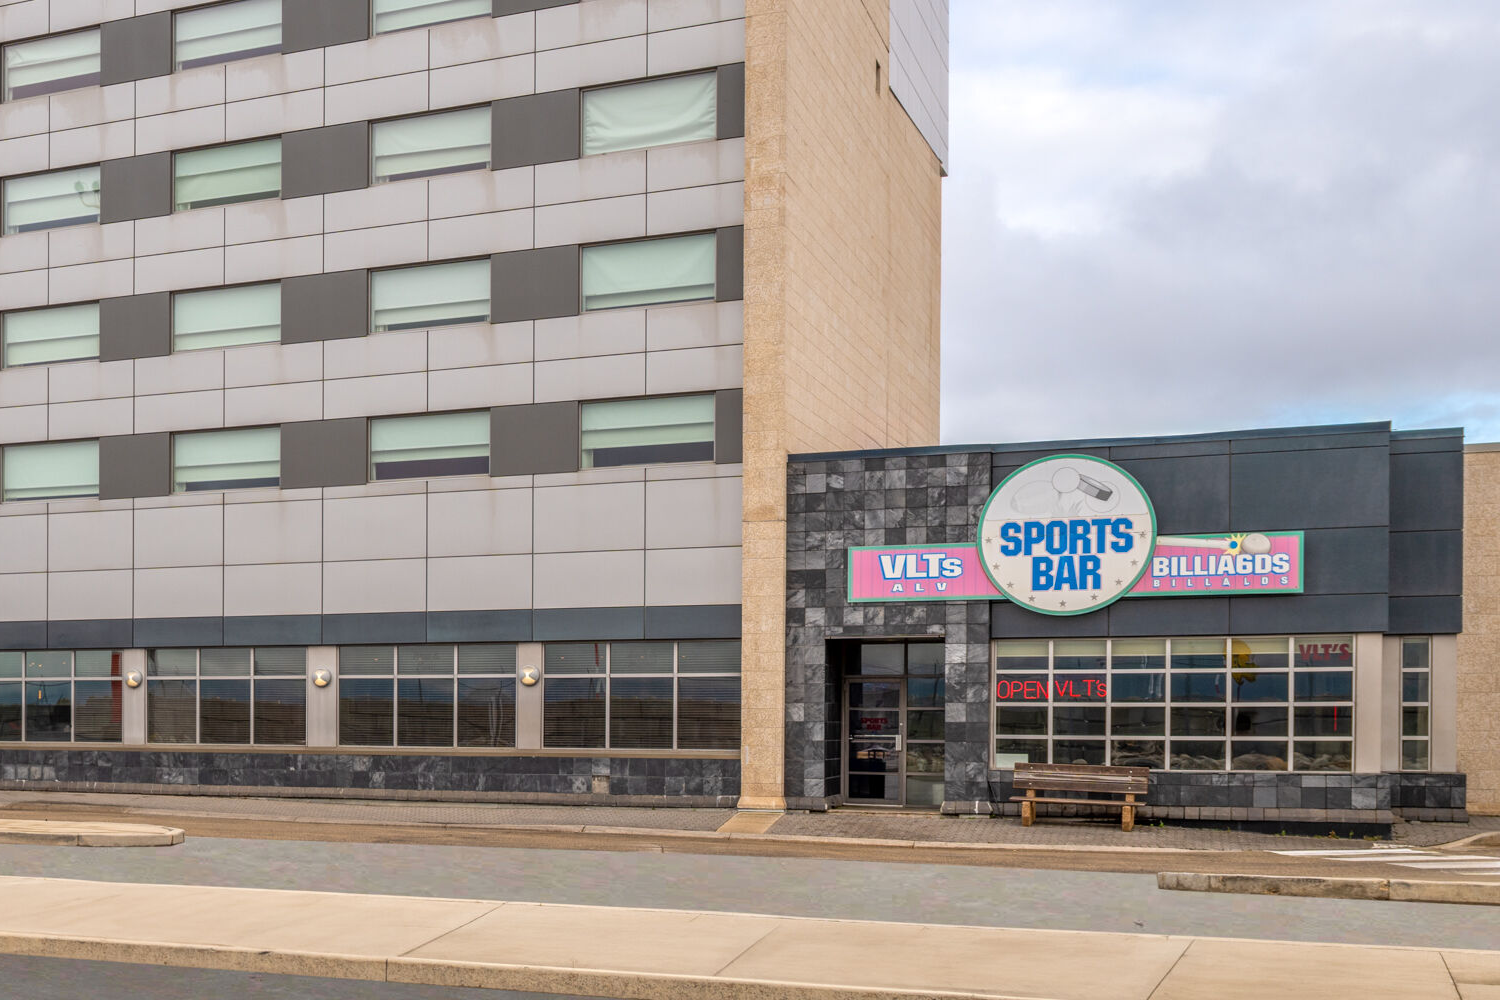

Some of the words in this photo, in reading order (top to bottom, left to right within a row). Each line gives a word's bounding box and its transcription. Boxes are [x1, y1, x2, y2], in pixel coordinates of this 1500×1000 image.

[1000, 517, 1134, 557] SPORTS
[1031, 554, 1102, 591] BAR
[1299, 643, 1351, 661] VLT'S
[996, 680, 1050, 700] OPEN
